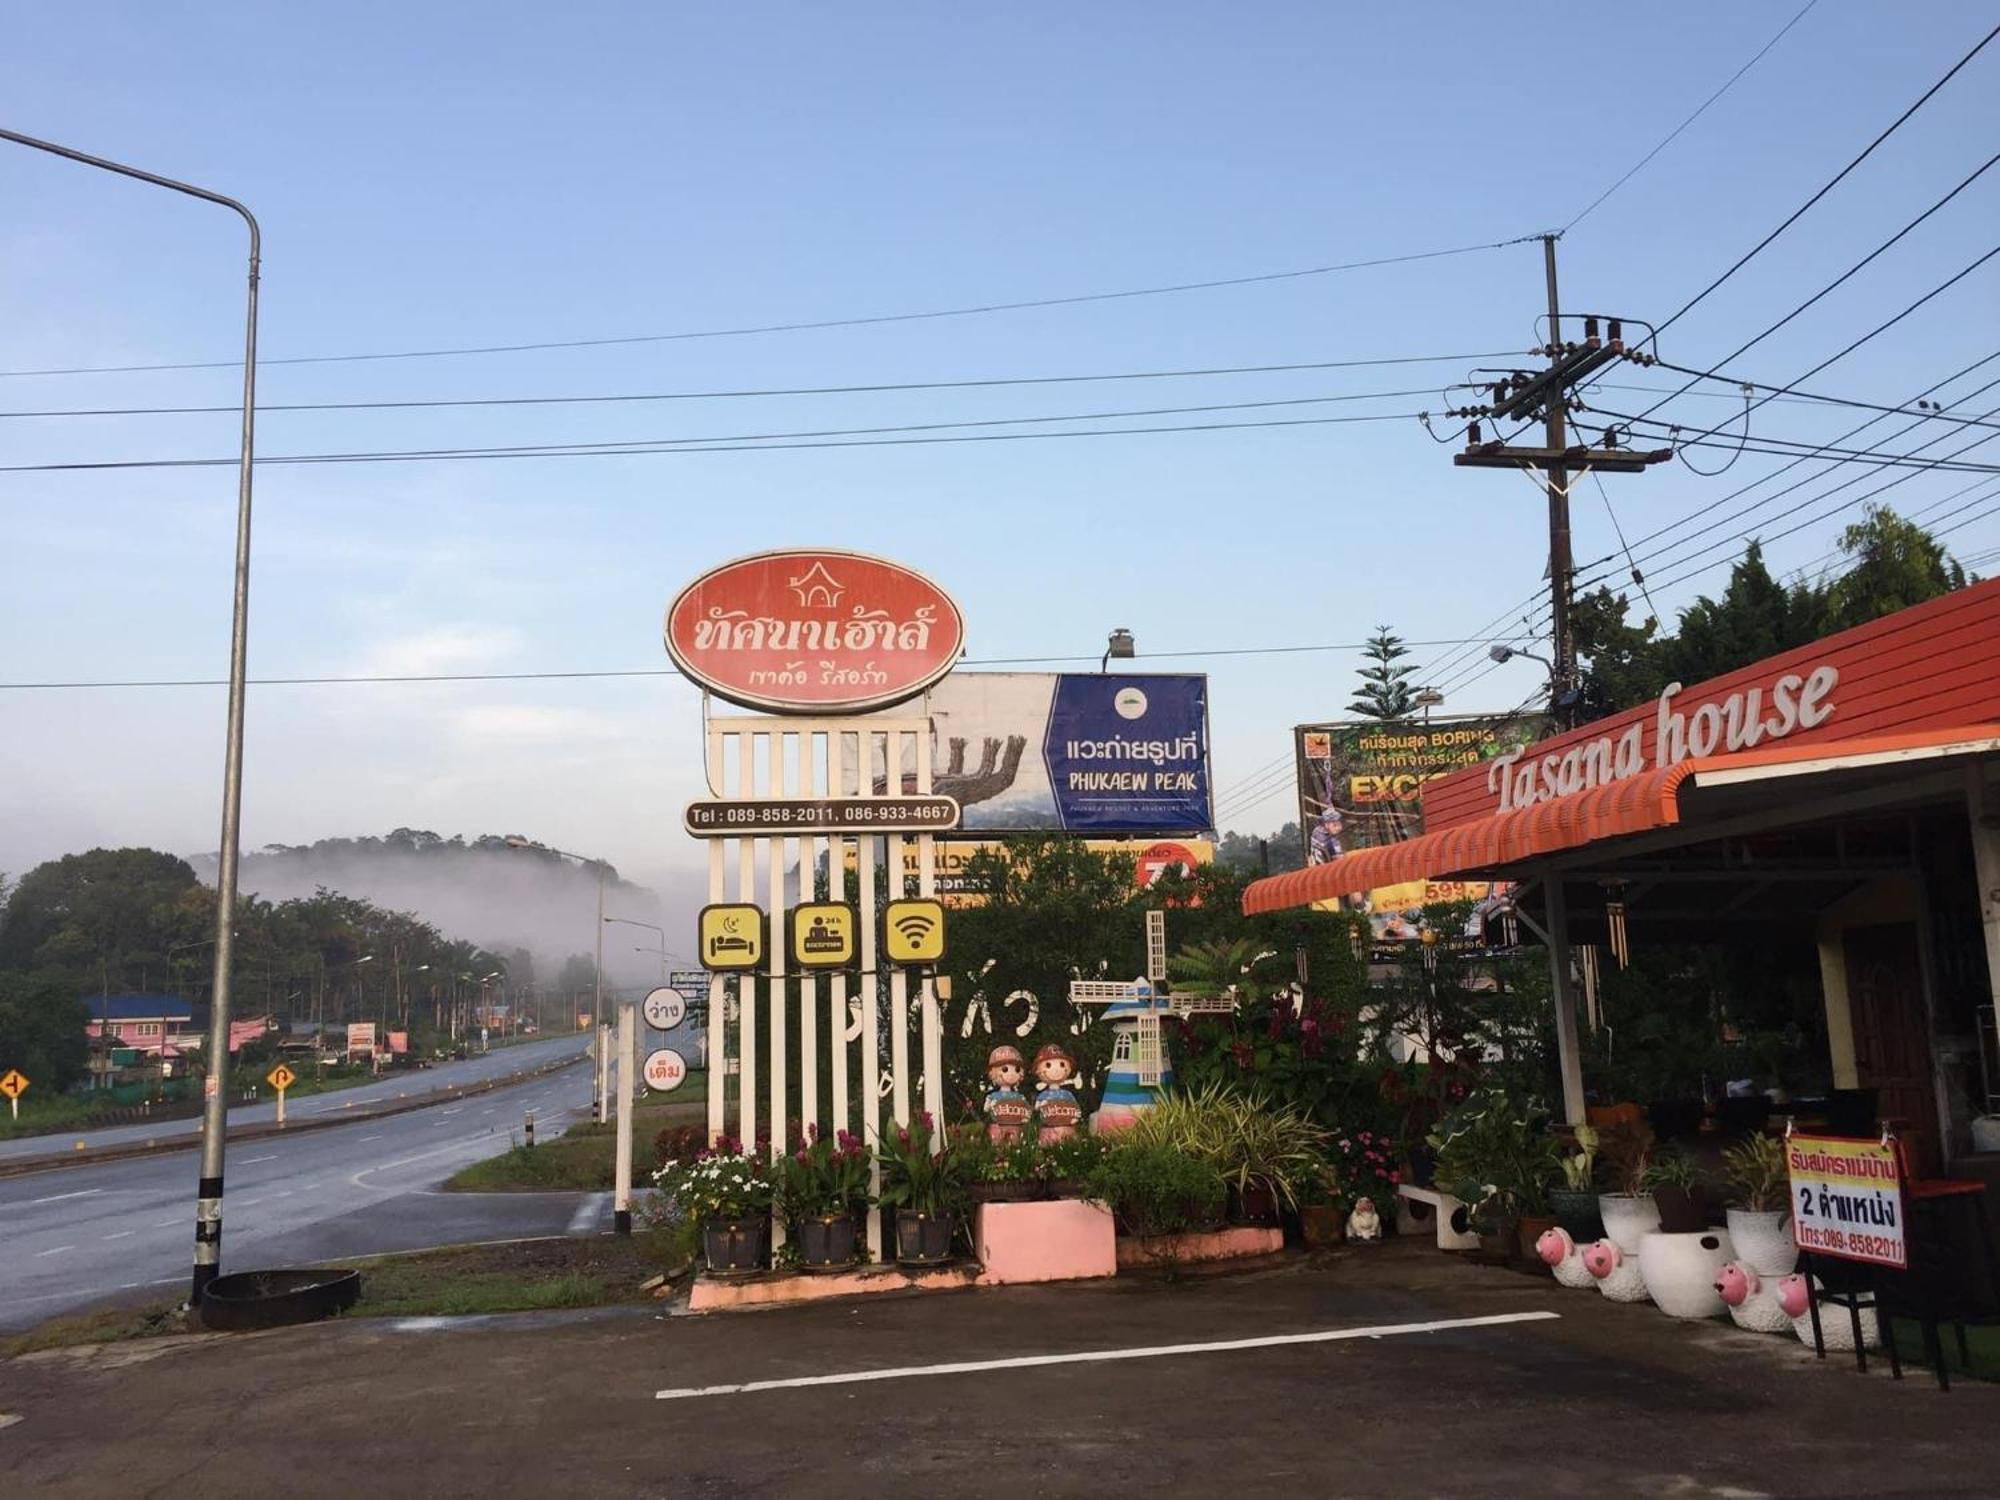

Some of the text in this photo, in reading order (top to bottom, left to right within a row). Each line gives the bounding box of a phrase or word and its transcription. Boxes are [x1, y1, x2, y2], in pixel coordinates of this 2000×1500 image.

[694, 604, 938, 650] ทัศนาเฮ้าส์
[749, 660, 888, 685] เขาค้อ รีสอร์ท
[1067, 731, 1198, 766] แวะถ่ายรูปที่
[1432, 730, 1495, 746] BORING
[1488, 666, 1840, 815] Tasana house
[1069, 772, 1198, 791] PHUKAEW PEAK
[727, 808, 839, 823] 089-858-2011,
[845, 806, 949, 821] 086-933-4667
[649, 1001, 679, 1019] ว่าง
[649, 1059, 680, 1079] เต็ม
[1791, 1147, 1896, 1180] รับสมัครแม่บ้าน
[1801, 1183, 1896, 1228] 2 ตำแหน่ง
